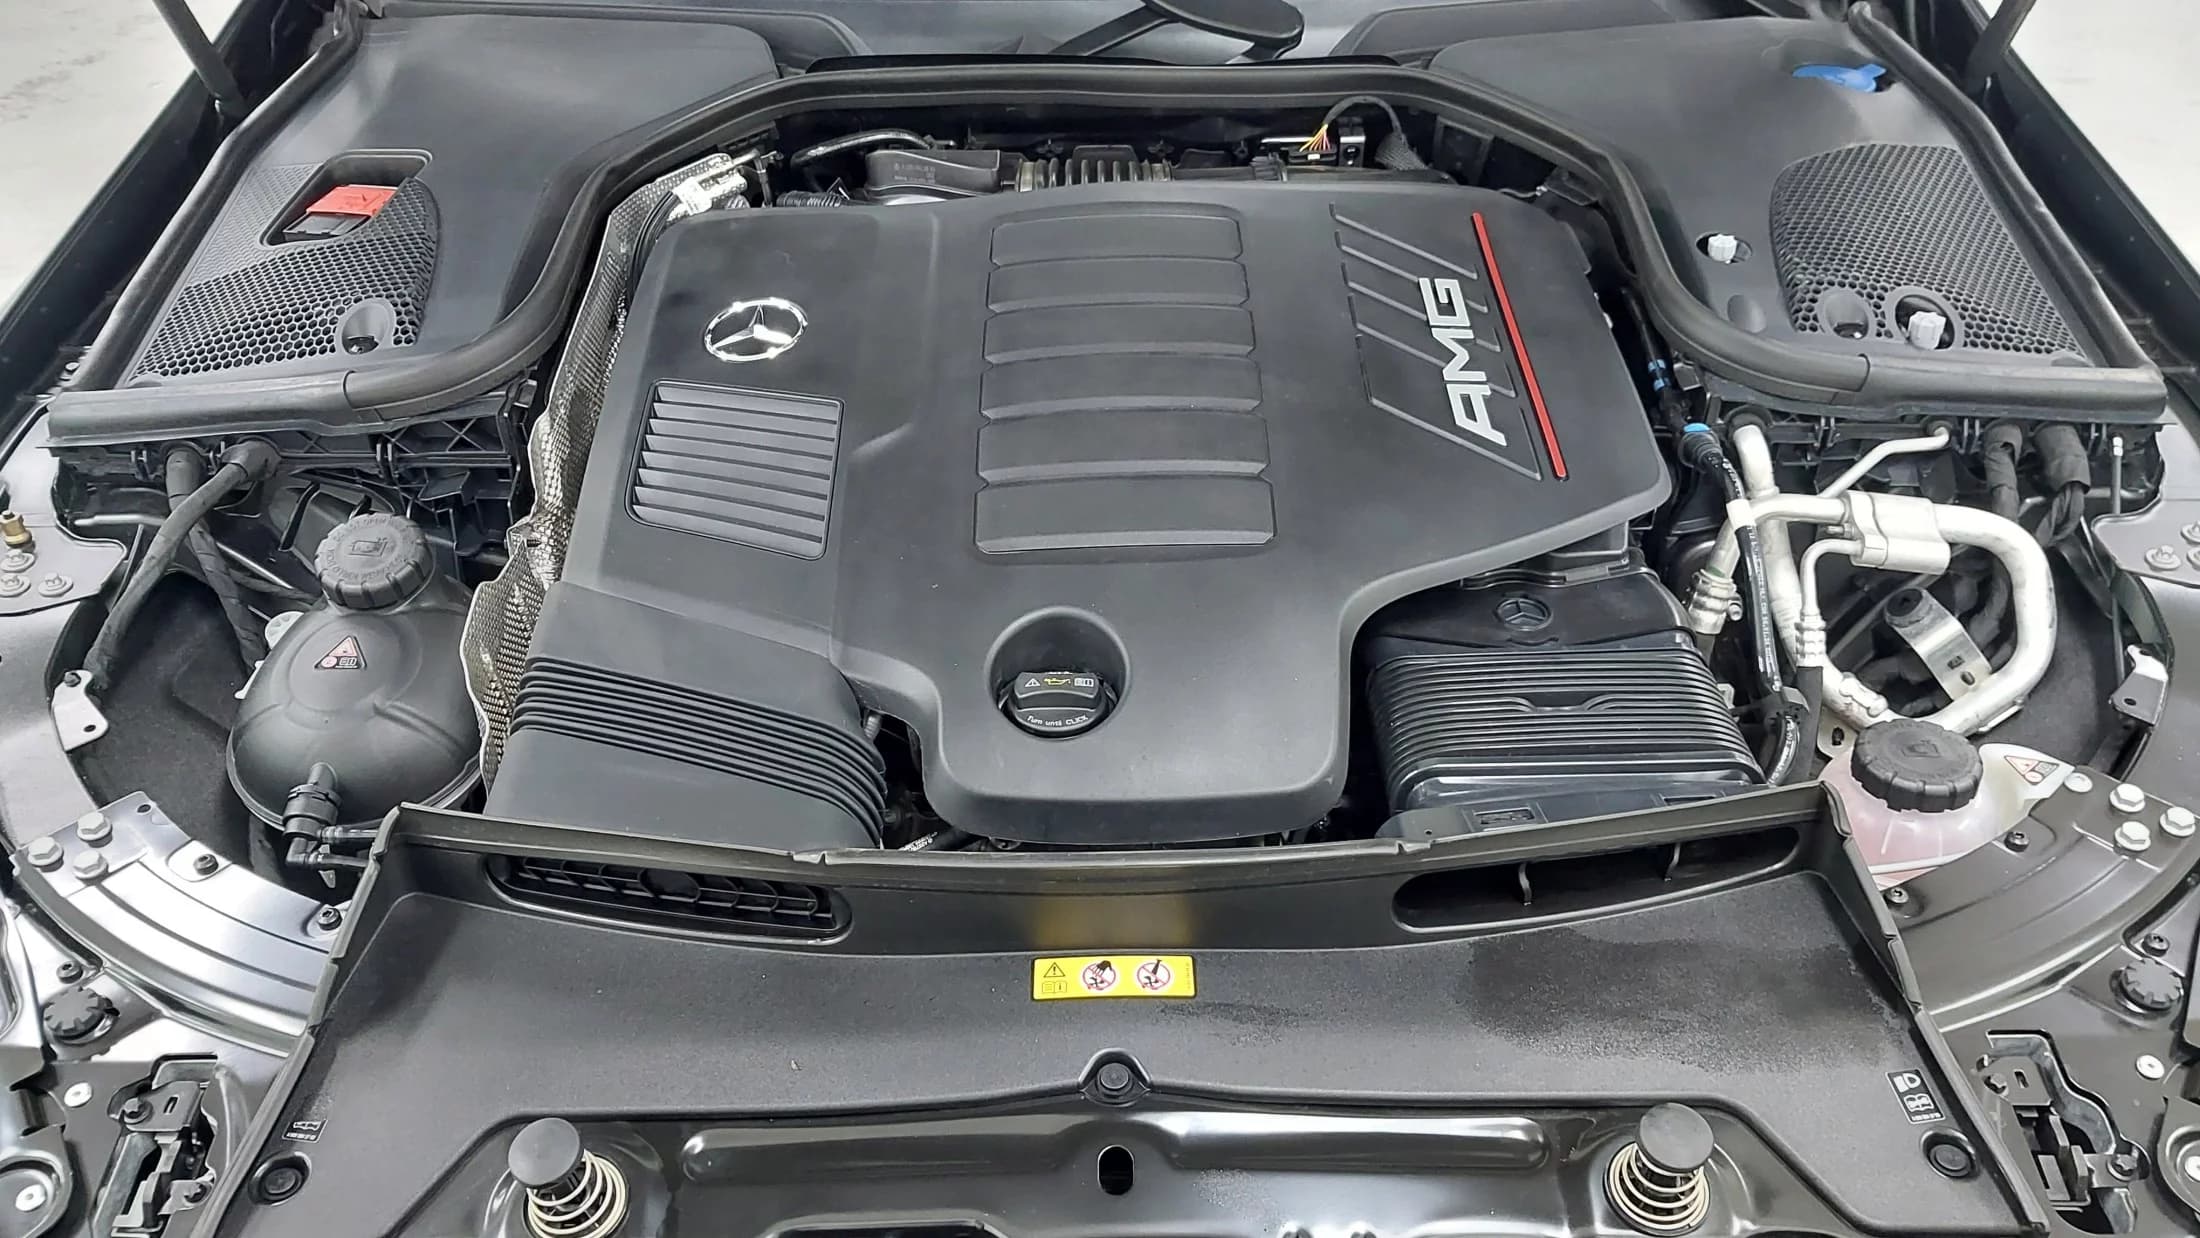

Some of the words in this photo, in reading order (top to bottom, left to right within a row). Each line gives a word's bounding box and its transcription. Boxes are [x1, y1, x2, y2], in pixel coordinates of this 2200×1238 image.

[1419, 278, 1507, 446] AMG
[1027, 715, 1042, 725] Turn
[1065, 715, 1088, 725] CLICK
